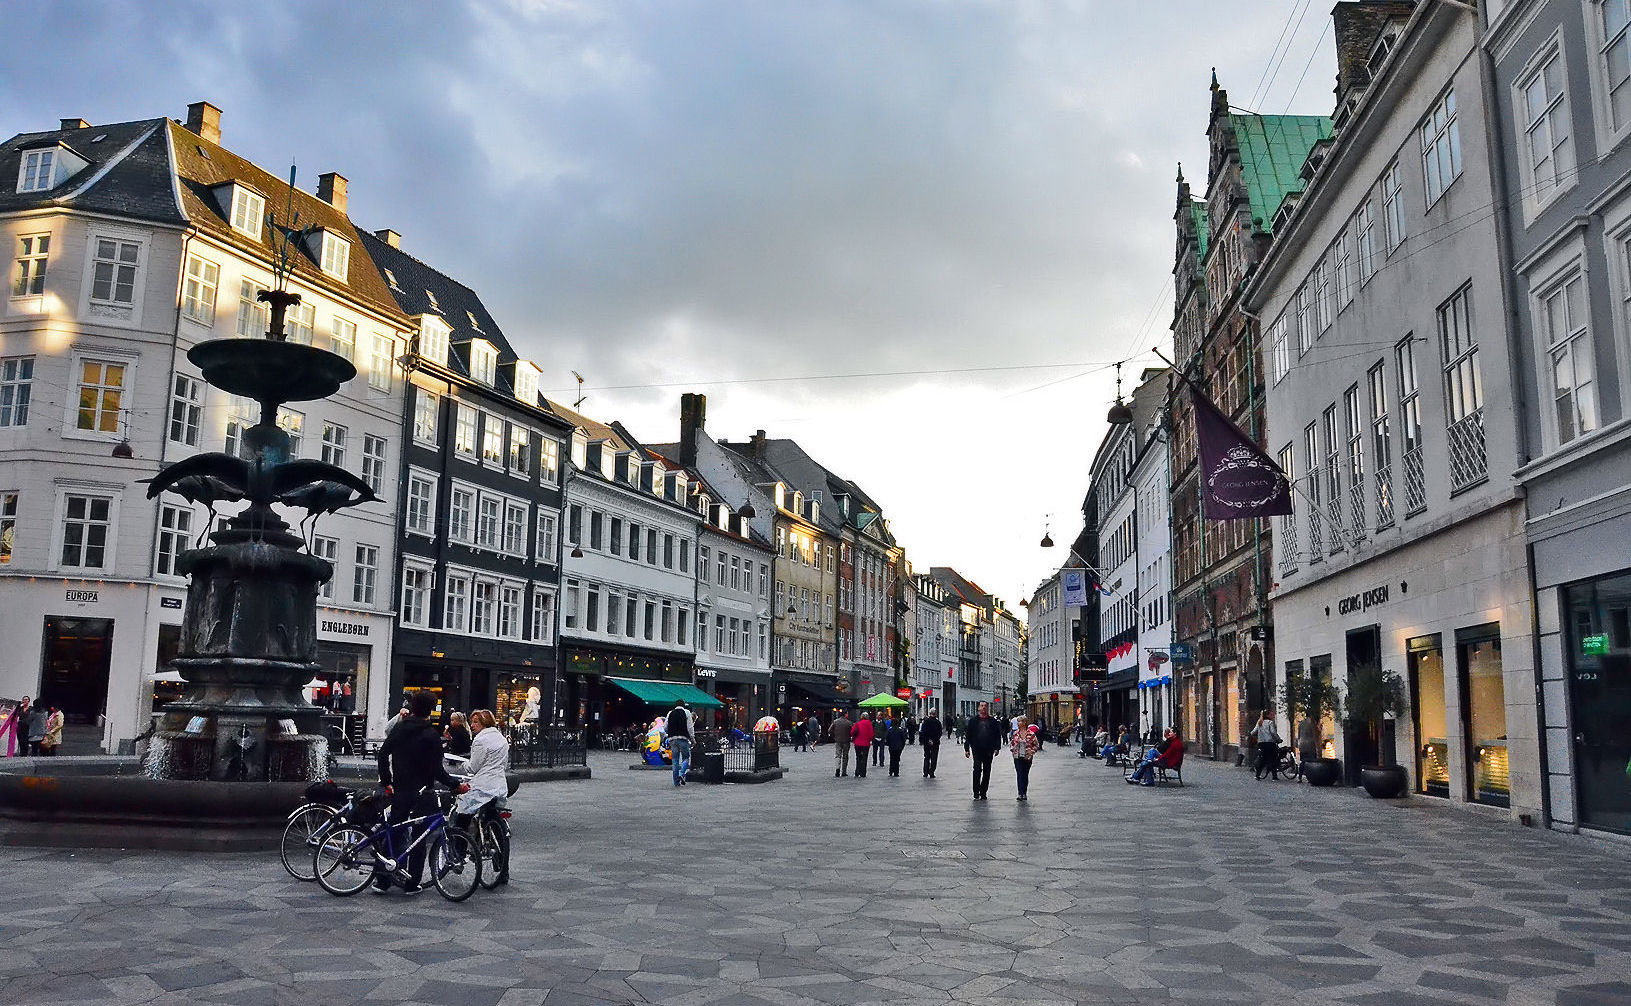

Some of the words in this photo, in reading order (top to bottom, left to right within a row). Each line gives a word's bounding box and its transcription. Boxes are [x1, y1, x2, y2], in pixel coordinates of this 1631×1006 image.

[65, 590, 98, 602] EUROPA
[1338, 593, 1361, 615] GEORG
[1362, 585, 1389, 613] JENSEN
[321, 620, 370, 636] ENGLEBØRN
